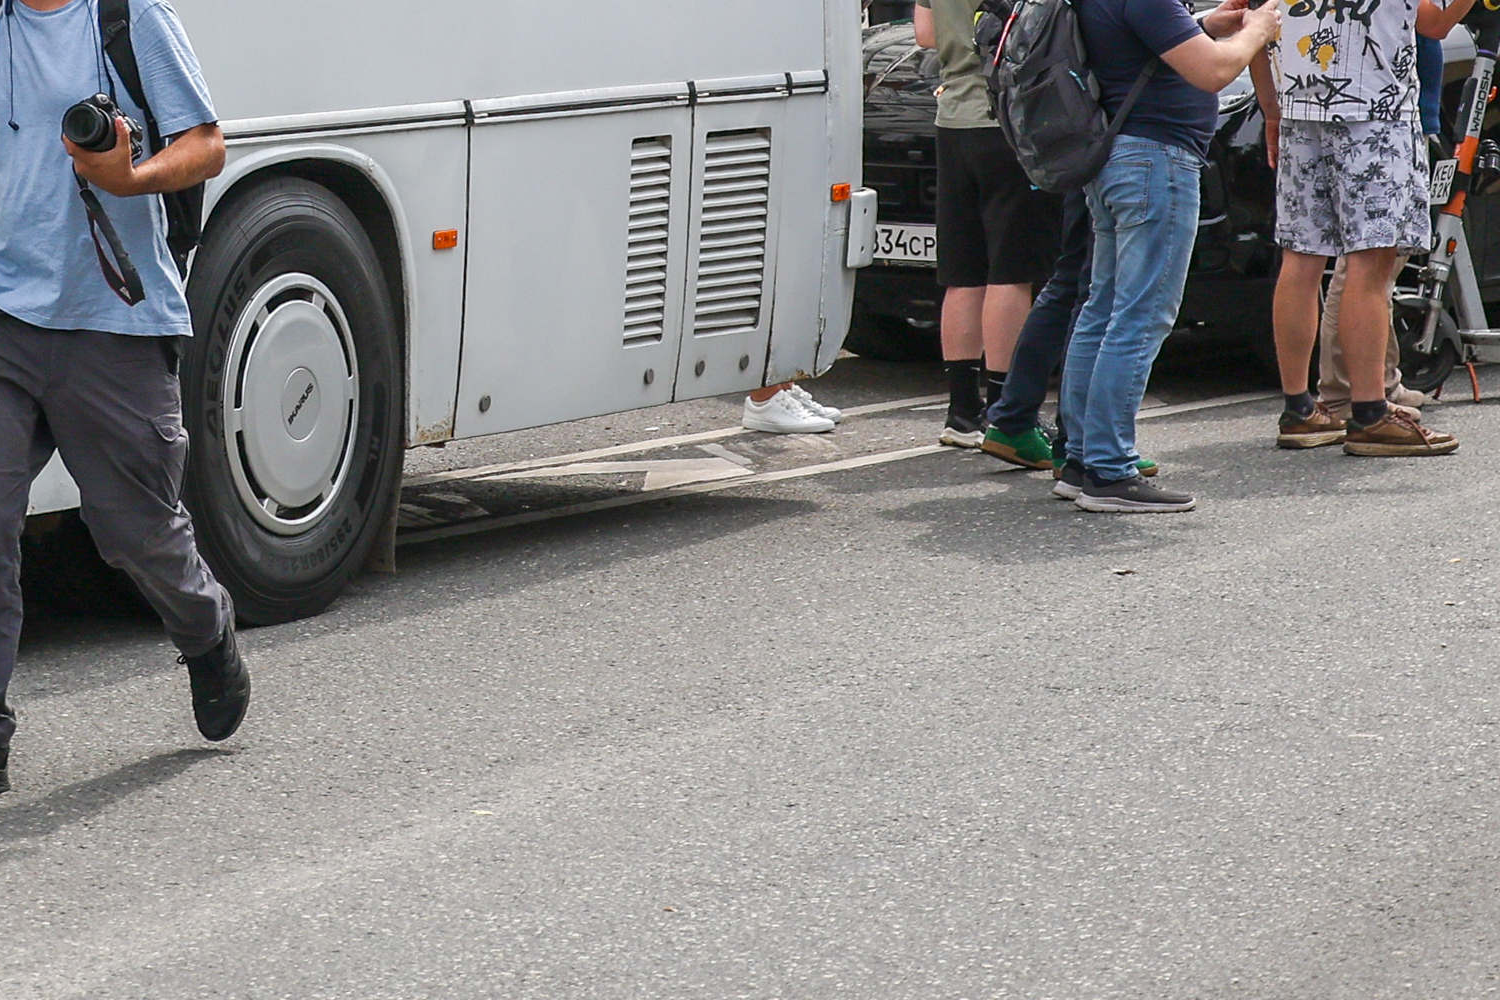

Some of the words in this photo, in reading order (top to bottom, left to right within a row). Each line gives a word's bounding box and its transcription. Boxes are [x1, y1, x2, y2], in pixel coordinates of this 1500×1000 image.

[1471, 69, 1491, 132] WHOOSH
[207, 272, 248, 441] AEOLUS
[287, 382, 314, 426] IKARUS
